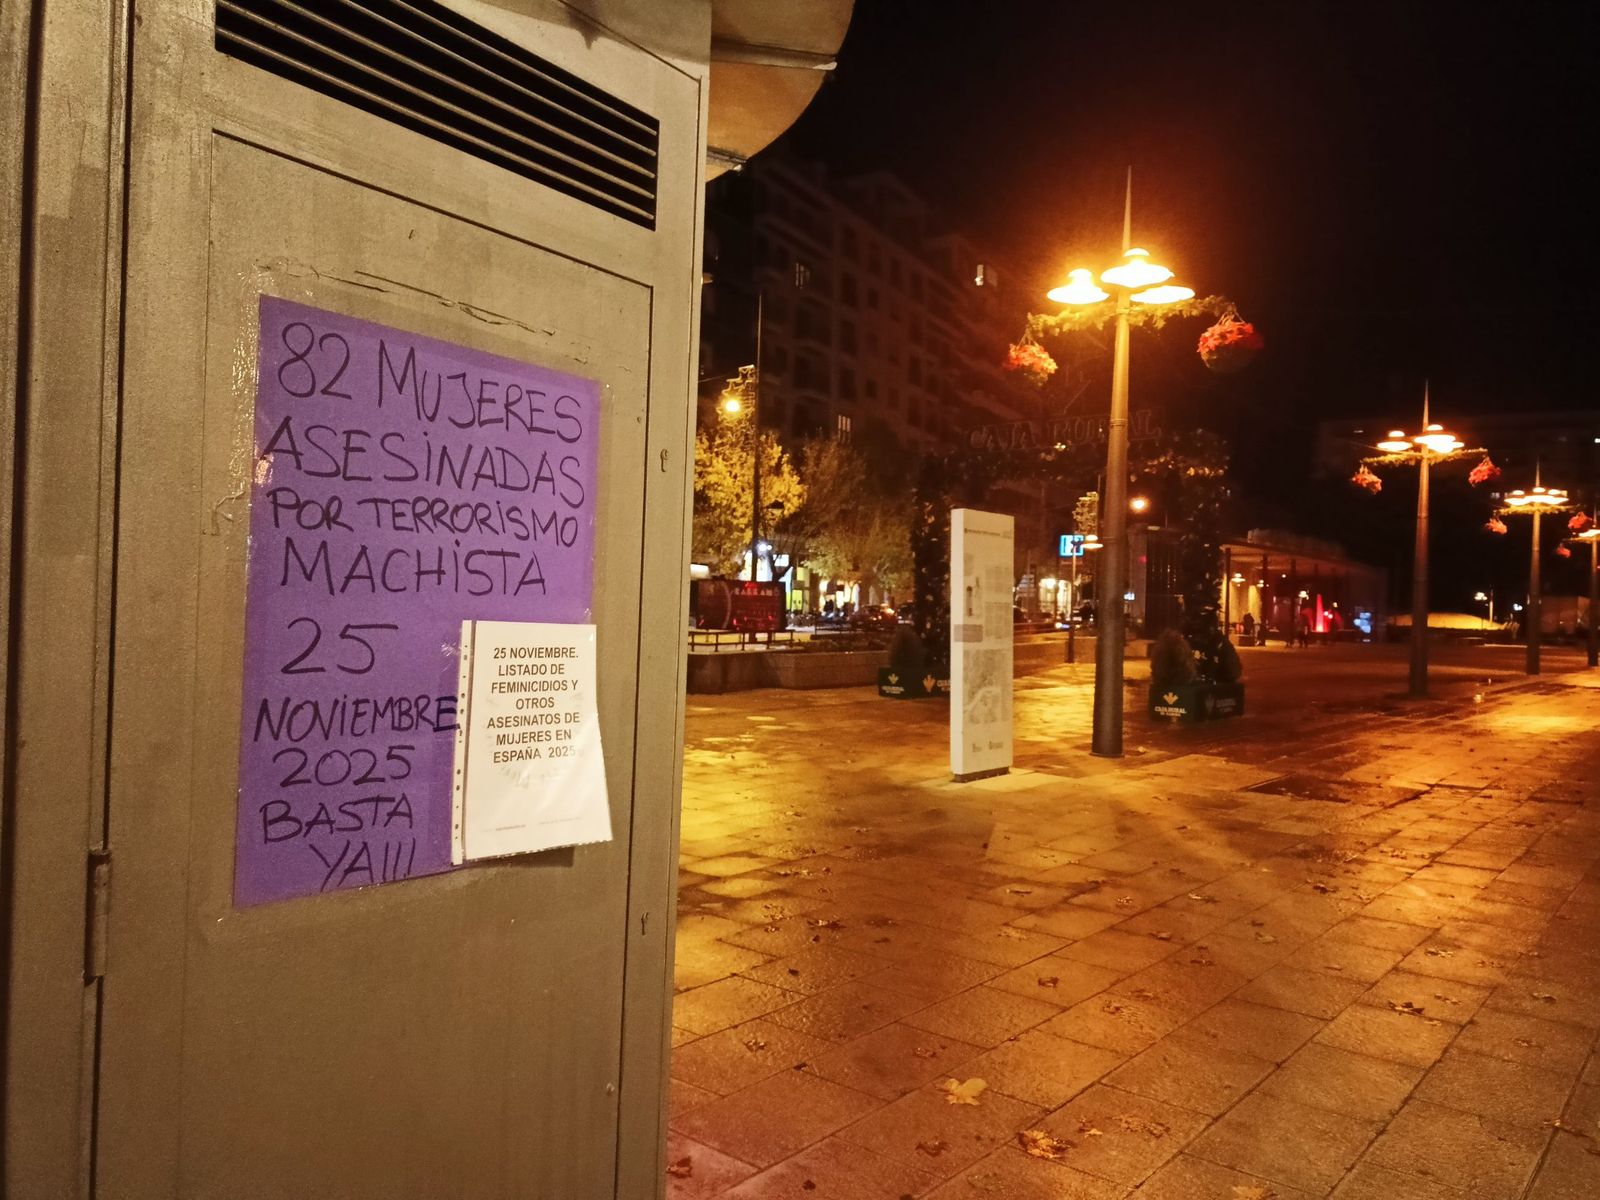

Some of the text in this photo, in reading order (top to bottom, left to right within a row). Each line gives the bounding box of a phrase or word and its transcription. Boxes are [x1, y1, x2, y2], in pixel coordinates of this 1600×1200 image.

[278, 322, 583, 443] 82 MUJERES
[266, 486, 354, 532] POR
[280, 617, 399, 675] 25
[493, 646, 579, 659] 25 NOVIEMBRE.
[498, 663, 565, 677] LISTADO DE
[491, 679, 579, 694] FEMINICIDIOS Y
[515, 697, 555, 710] OTROS
[487, 711, 581, 729] ASESINATOS DE
[496, 729, 572, 746] MUJERES EN
[493, 745, 576, 764] ESPAÑA 2025
[272, 745, 415, 788] 2025
[260, 793, 413, 844] BASTA
